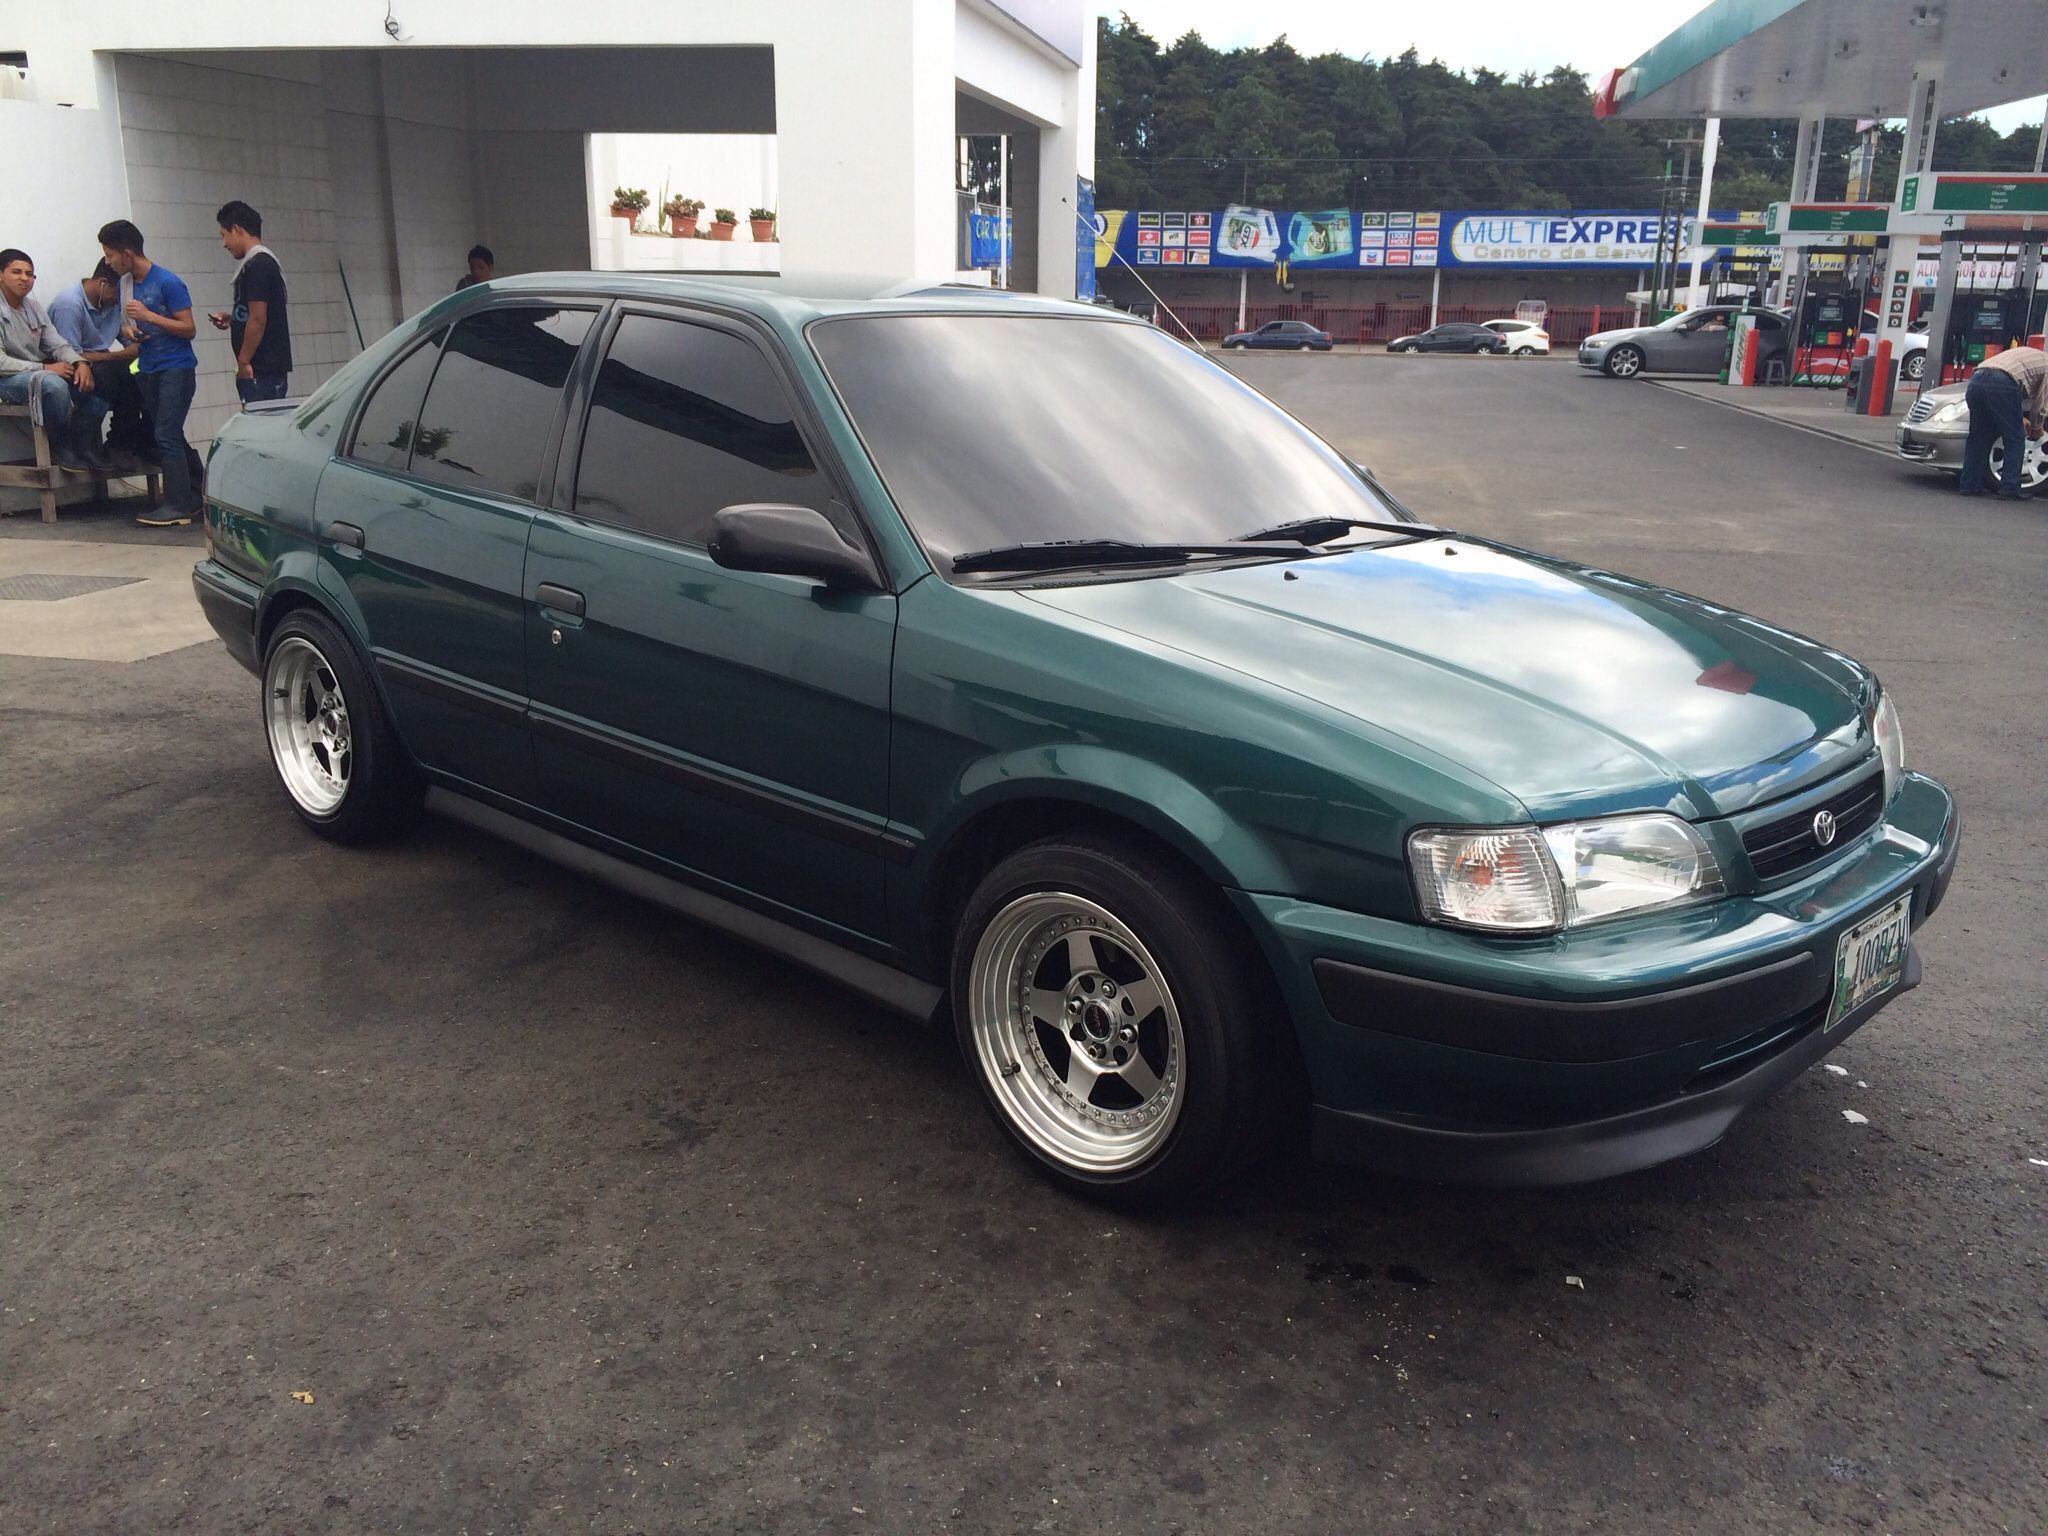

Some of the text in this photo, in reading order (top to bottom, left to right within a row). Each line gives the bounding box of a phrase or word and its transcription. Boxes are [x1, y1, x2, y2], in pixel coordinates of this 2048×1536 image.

[1944, 214, 1954, 227] 4
[1474, 245, 1552, 259] Centro
[1560, 245, 1585, 259] de
